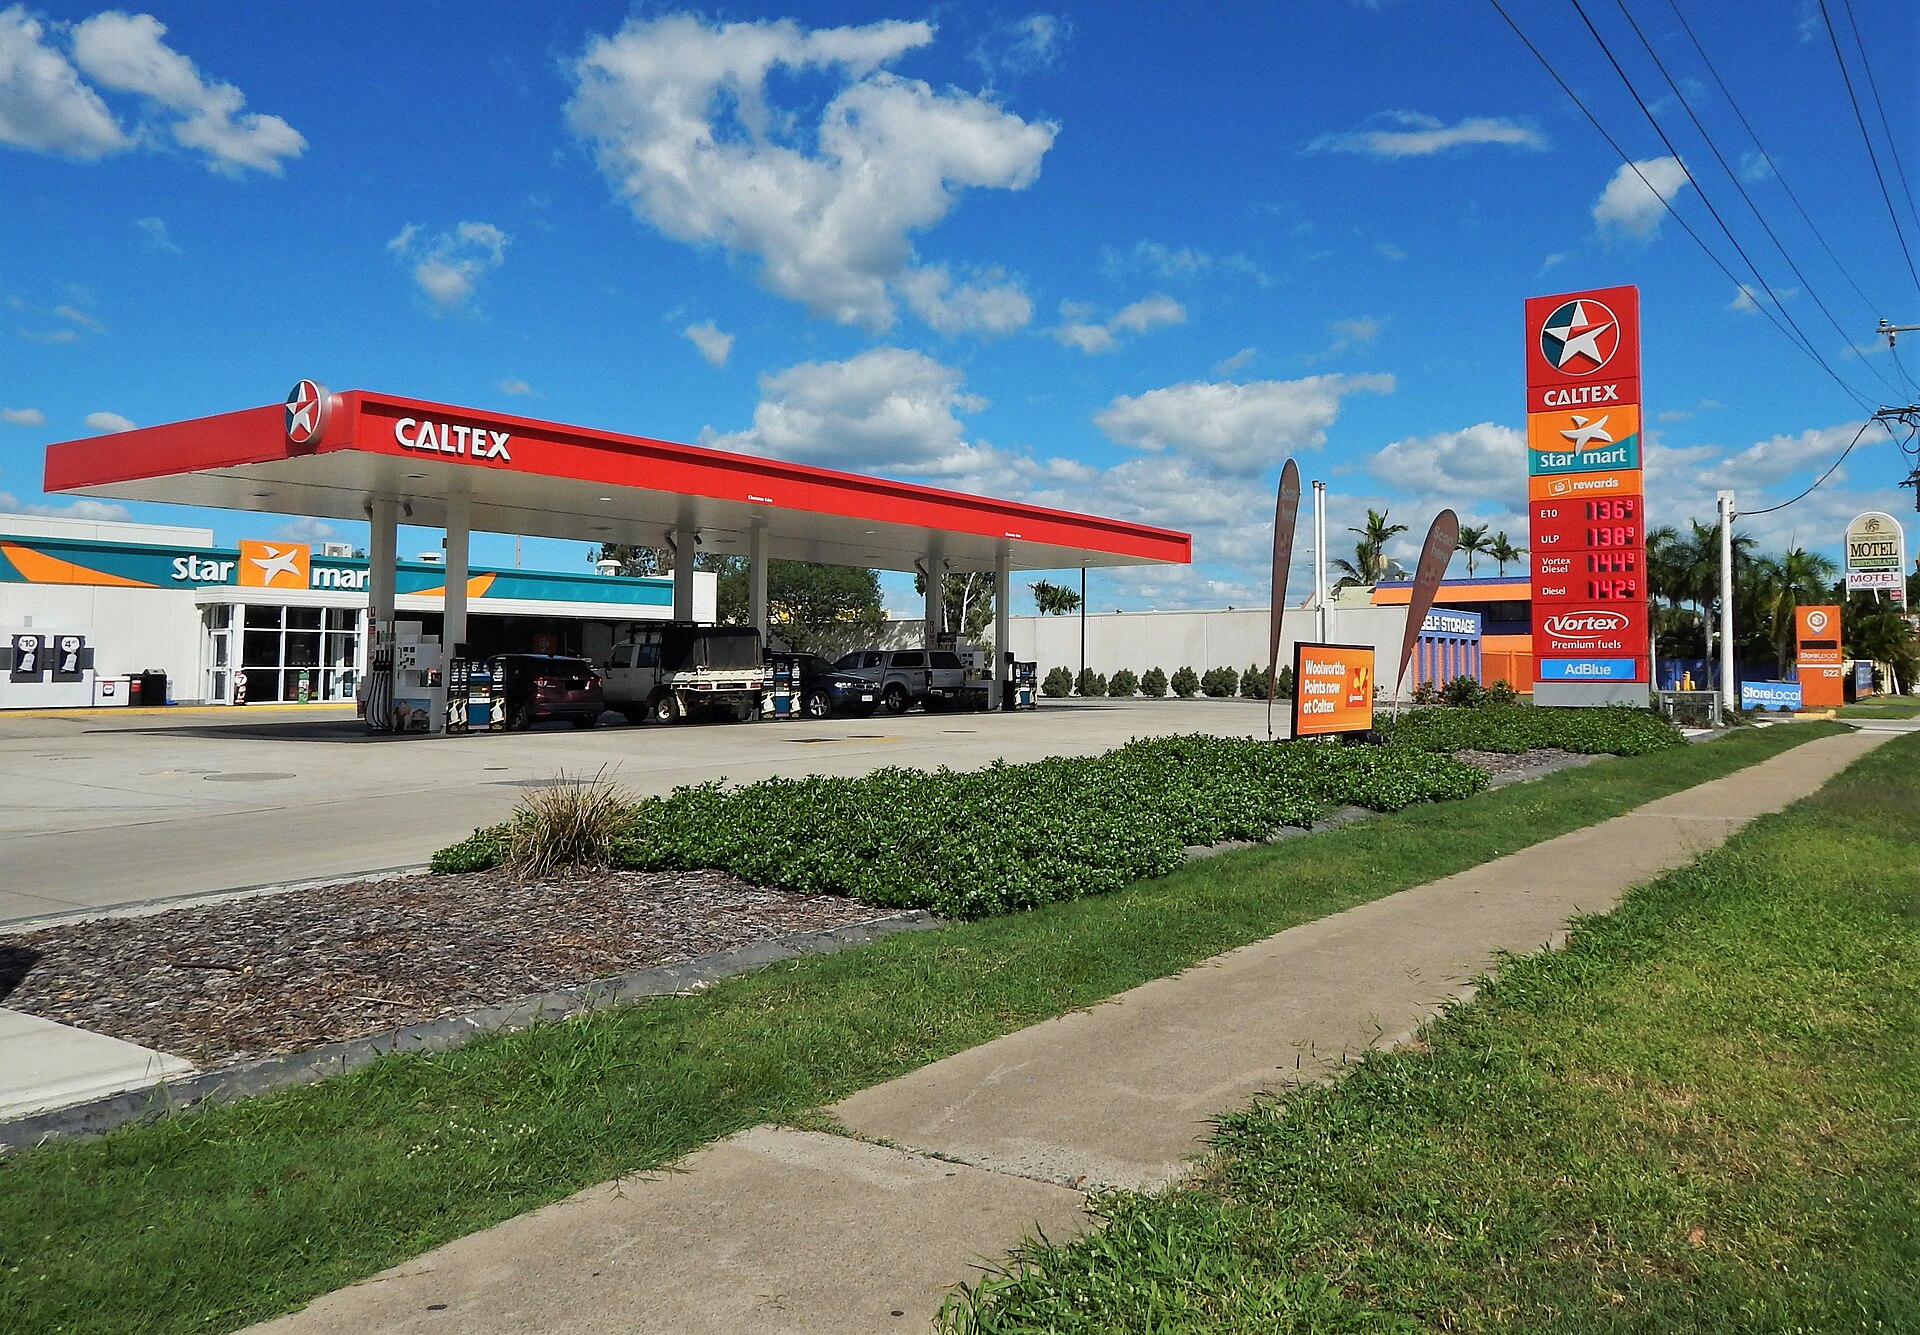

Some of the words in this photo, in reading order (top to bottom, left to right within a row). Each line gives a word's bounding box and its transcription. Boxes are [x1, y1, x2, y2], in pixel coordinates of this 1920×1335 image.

[1544, 384, 1619, 407] CALTEX
[396, 417, 511, 460] CALTEX
[1540, 453, 1575, 468] star
[1583, 447, 1627, 465] mart
[1573, 477, 1619, 490] rewards
[1540, 509, 1558, 518] E10
[1541, 535, 1559, 544] ULP
[1850, 542, 1897, 557] MOTEL
[1542, 557, 1571, 565] Vortex
[172, 555, 236, 582] star
[312, 567, 370, 588] mar
[1541, 565, 1568, 574] Diesel
[1850, 573, 1899, 583] MOTEL
[1542, 587, 1566, 595] Diesel
[1441, 616, 1476, 634] STORAGE
[1548, 616, 1619, 631] Vortex
[1551, 640, 1595, 649] Premium
[1597, 639, 1622, 649] fuels
[1305, 659, 1346, 676] Woolworths
[1564, 663, 1612, 675] AdBlue
[1823, 669, 1840, 677] 522
[1304, 679, 1326, 694] Points
[1326, 683, 1341, 694] now
[1742, 686, 1801, 701] StoreLocal
[1303, 701, 1312, 714] at
